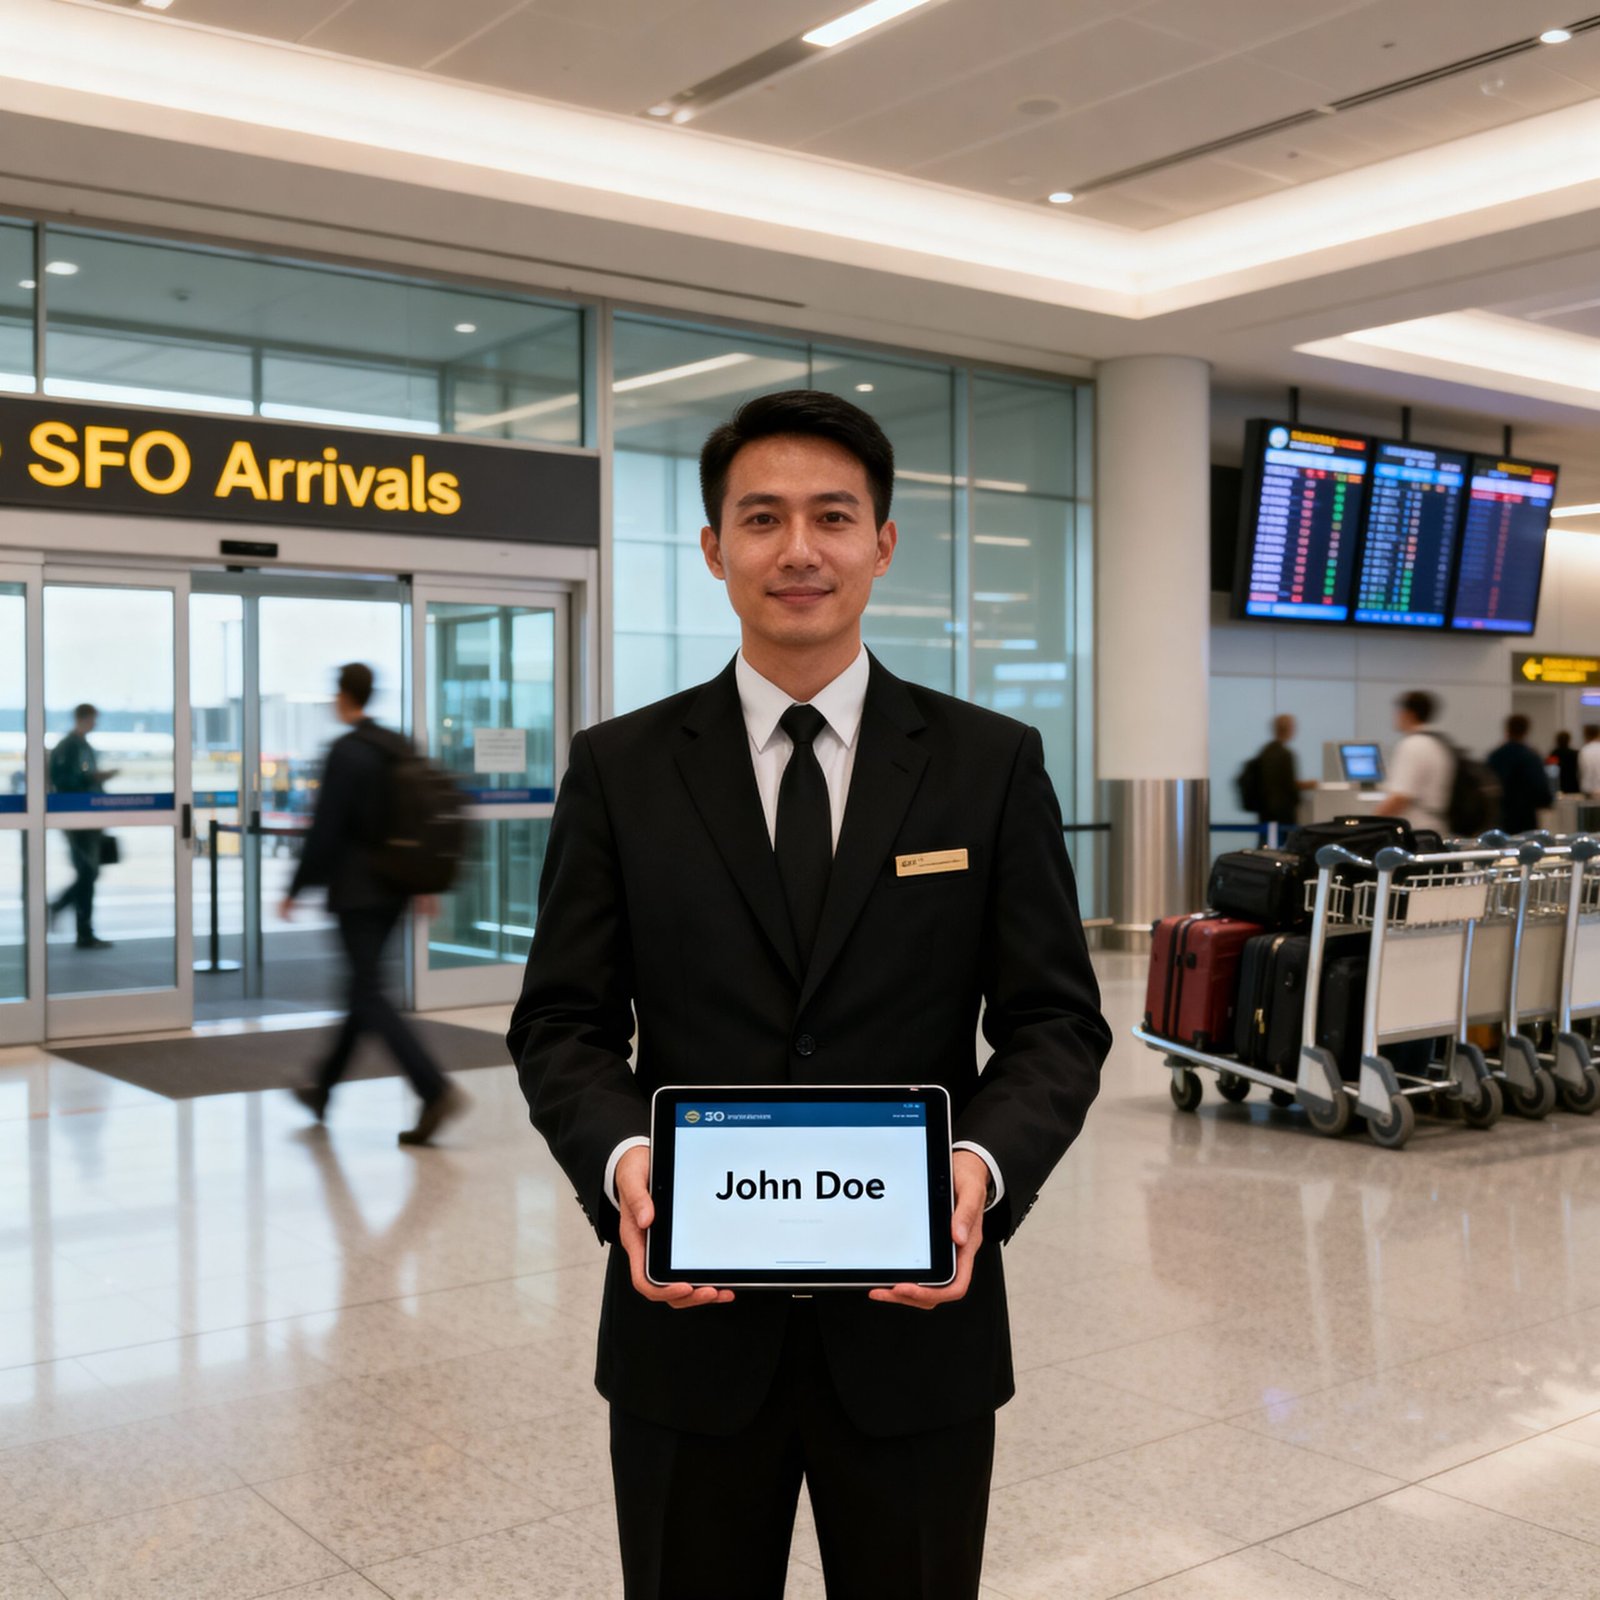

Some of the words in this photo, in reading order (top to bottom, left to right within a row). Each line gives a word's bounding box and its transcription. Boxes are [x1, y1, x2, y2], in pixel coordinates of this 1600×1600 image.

[27, 420, 192, 495] SFO
[214, 440, 462, 515] Arrivals
[715, 1170, 802, 1201] John
[816, 1170, 885, 1200] Doe
